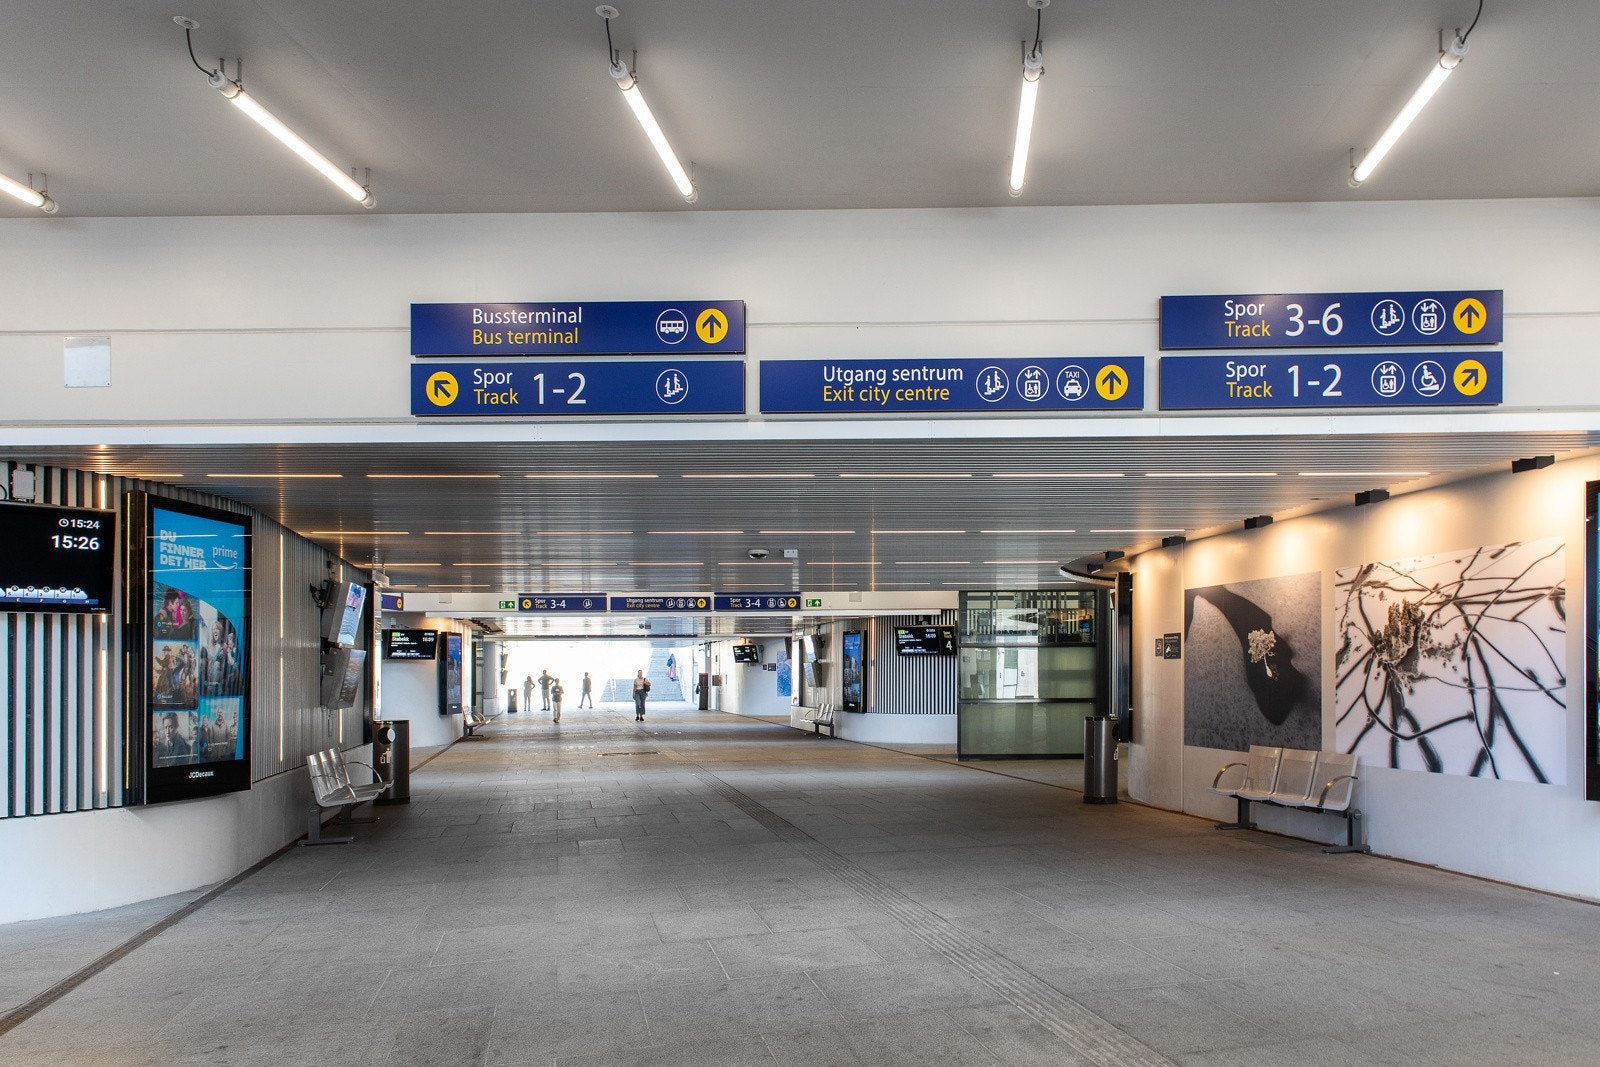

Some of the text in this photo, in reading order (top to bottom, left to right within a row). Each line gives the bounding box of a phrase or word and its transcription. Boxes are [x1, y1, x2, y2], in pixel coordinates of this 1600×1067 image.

[472, 307, 582, 324] Bussterminal
[1224, 300, 1265, 319] Spor
[1285, 302, 1343, 337] 3-6
[472, 328, 579, 345] Bus terminal
[1225, 321, 1271, 337] Track
[473, 368, 513, 389] Spor
[823, 366, 963, 386] Utgang sentrum
[1065, 371, 1080, 379] TAXI
[1226, 361, 1266, 381] Spor
[533, 372, 587, 404] 1-2
[1287, 364, 1343, 397] 1-2
[473, 389, 519, 405] Track
[823, 385, 950, 406] Exit city centre
[1226, 382, 1273, 398] Track
[70, 519, 100, 529] 15:24
[51, 535, 100, 550] 15:26
[160, 530, 176, 542] DU
[160, 542, 204, 558] FINNER
[212, 545, 238, 559] prime
[160, 554, 207, 570] DET HER
[550, 599, 566, 609] 3-4
[745, 598, 761, 608] 3-4
[945, 640, 953, 650] 4
